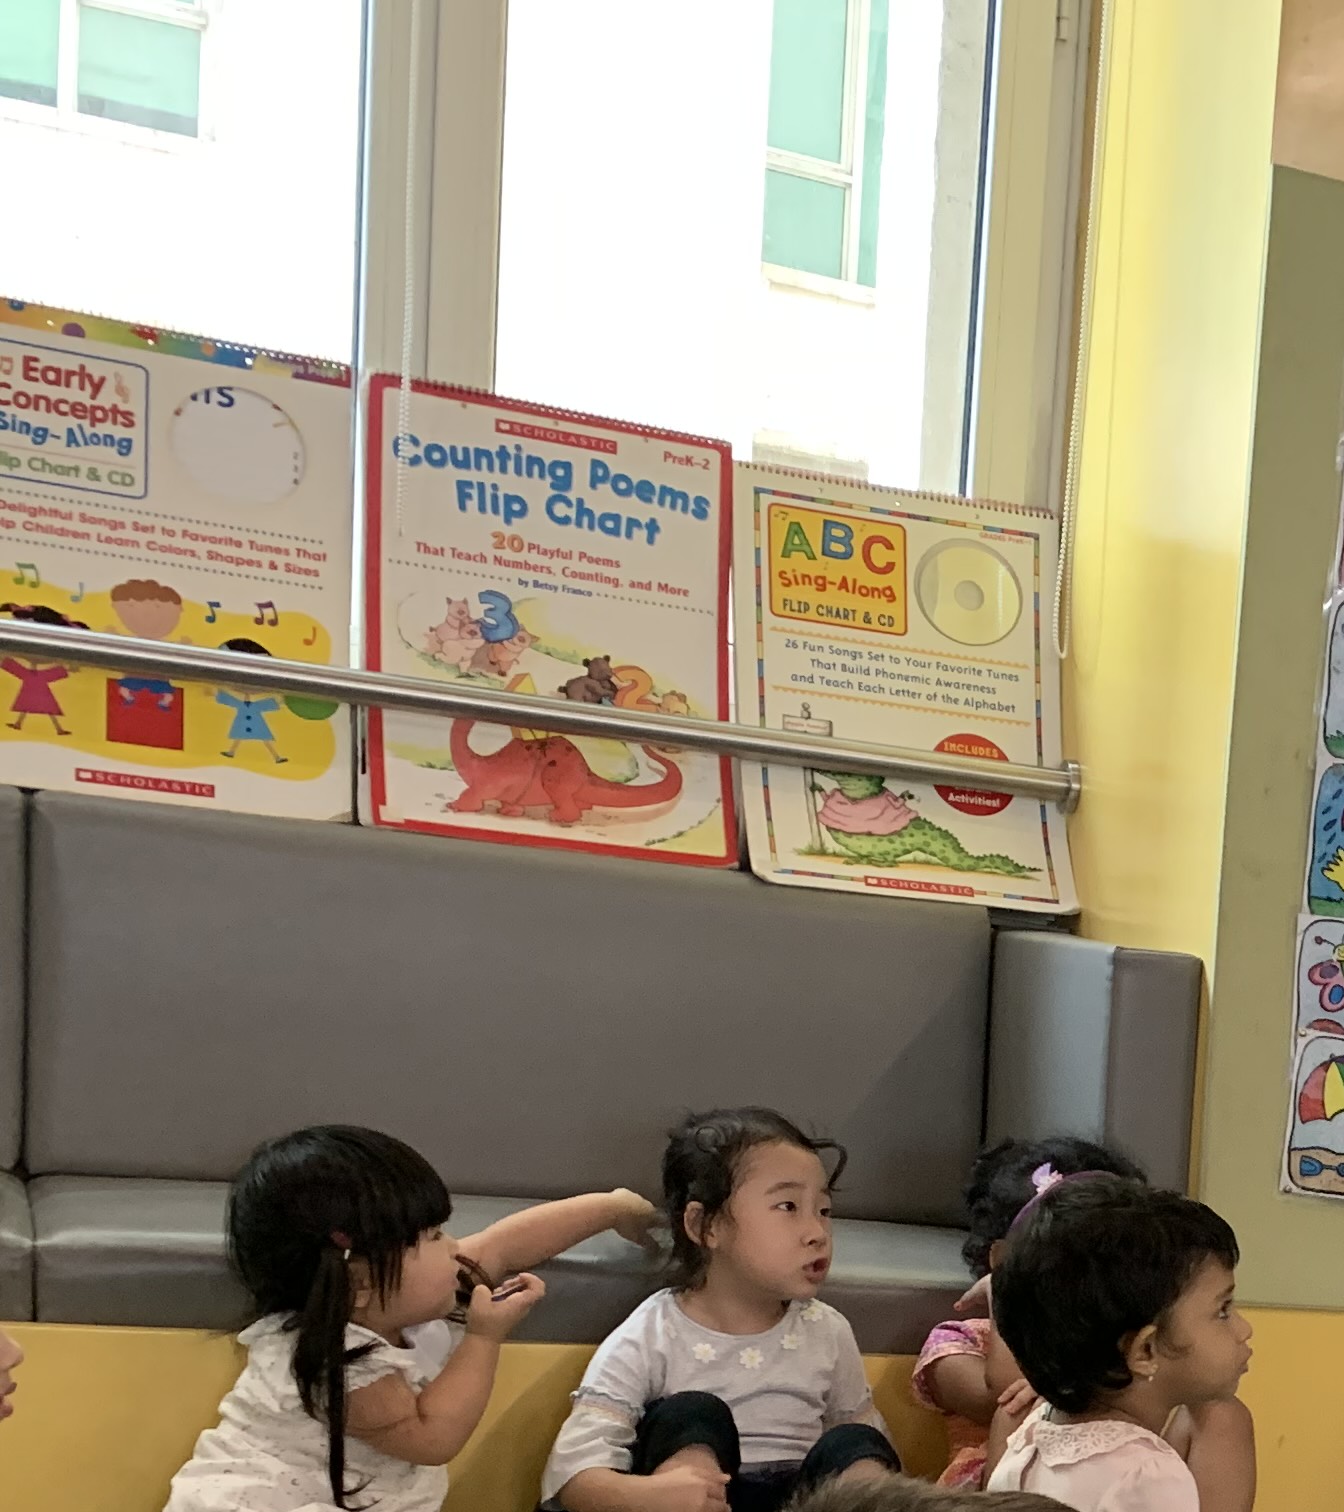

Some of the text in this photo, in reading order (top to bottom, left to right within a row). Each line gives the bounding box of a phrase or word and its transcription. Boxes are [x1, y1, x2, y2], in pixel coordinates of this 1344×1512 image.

[22, 355, 106, 400] Early
[513, 424, 615, 451] SCHOLASTIC
[27, 457, 135, 487] Chart & CD
[393, 434, 711, 520] Counting Poems
[456, 479, 660, 545] Flip Chart
[23, 521, 90, 540] Children
[97, 533, 140, 548] Learn
[206, 550, 262, 566] Shapes
[268, 561, 278, 571] &
[284, 563, 320, 577] Sizes
[79, 513, 125, 531] Songs
[132, 521, 155, 534] Set
[162, 526, 176, 537] to
[182, 529, 242, 548] Favorite
[249, 540, 290, 556] Tunes
[295, 548, 327, 562] That
[491, 532, 621, 568] 20 Playful Poems
[416, 541, 690, 597] That Teach Numbers, Counting, and More
[778, 569, 896, 603] Sing-Along
[782, 598, 895, 628] FLIP CHART & CD
[785, 638, 1019, 682] 26 Fun Songs Set to Your Favorite Tunes
[810, 659, 997, 695] That Build Phonemic Awareness
[791, 672, 1016, 713] and Teach Each Letter of the Alphabet
[943, 741, 999, 758] INCLUDES
[96, 772, 212, 796] SCHOLASTIC
[948, 793, 1000, 807] Activities!
[878, 878, 972, 896] SCHOLASTIC
